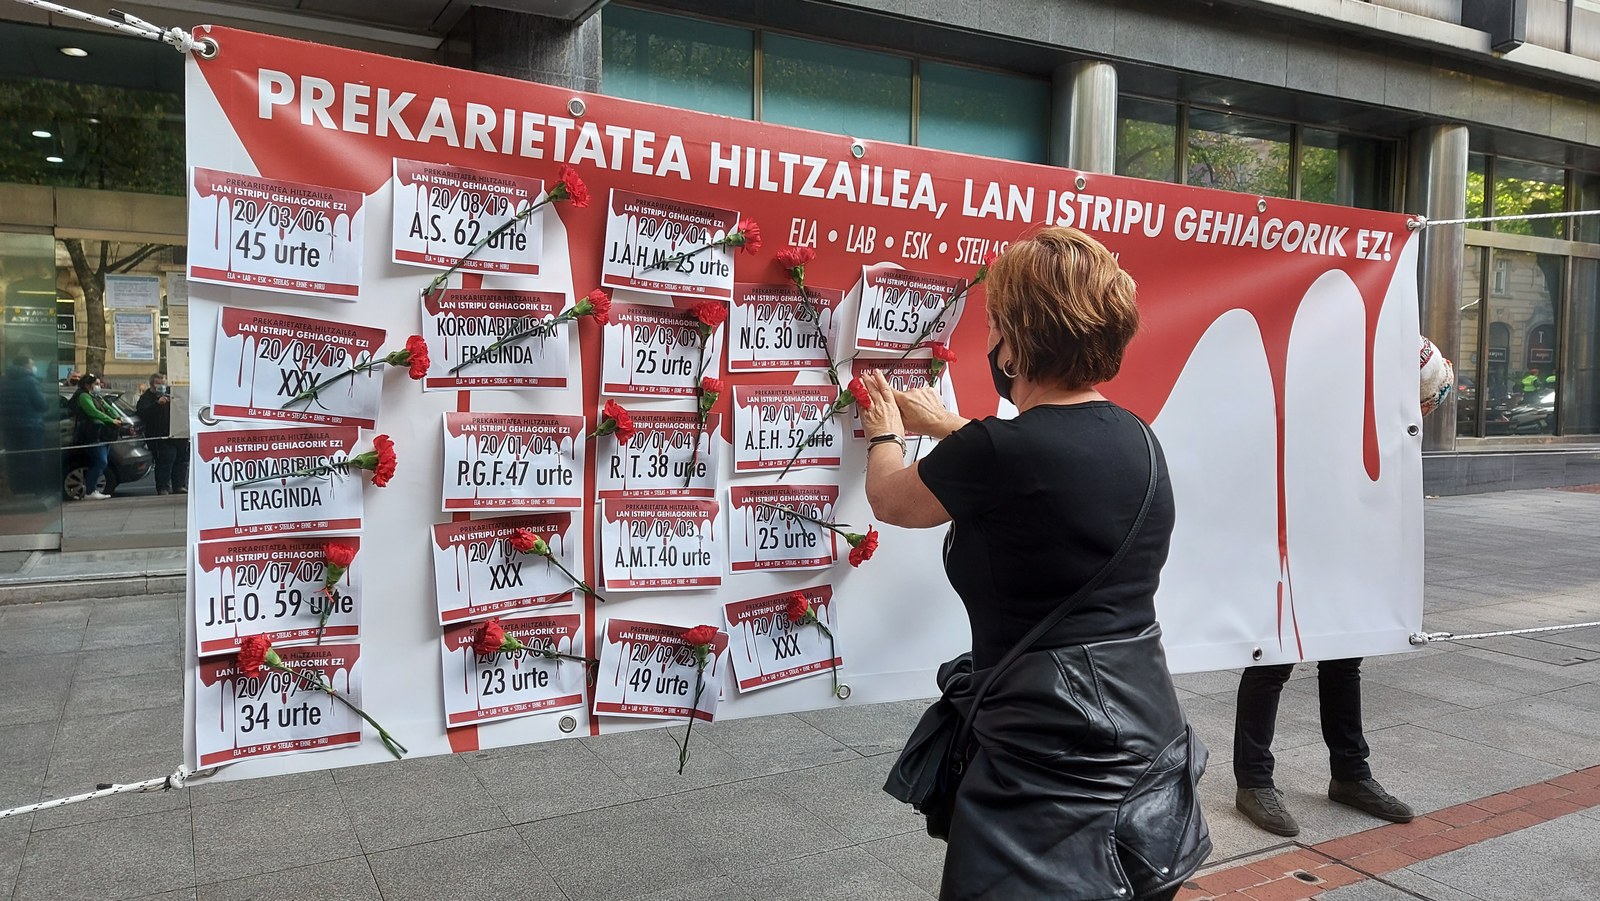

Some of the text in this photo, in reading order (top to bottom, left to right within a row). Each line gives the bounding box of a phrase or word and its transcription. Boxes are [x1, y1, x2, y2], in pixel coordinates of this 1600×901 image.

[258, 68, 1393, 262] PREKARIETATEA HILTZAILEA, LAN ISTRIPU GEHIAGORIK EZ!
[212, 184, 347, 210] LAN ISTRIPU GEHIAGORIK EZ!
[226, 178, 334, 200] PREKARIETATEA HILTZAILEA
[412, 173, 527, 197] LAN ISTRIPU GEHIAGORIK EZ!
[432, 188, 508, 218] 20/08/19
[234, 199, 325, 233] 20/03/06
[641, 207, 667, 217] ISTRIPU
[669, 212, 711, 224] GEHIAGORIK
[714, 219, 724, 228] EZ!
[410, 212, 446, 242] A.S.
[454, 219, 480, 246] 62
[640, 218, 706, 246] 20/09/04
[789, 217, 818, 248] ELA
[846, 224, 877, 254] LAB
[902, 230, 932, 259] ESK
[236, 230, 319, 267] 45 urte
[675, 252, 695, 273] 25
[700, 259, 729, 277] urte
[885, 288, 941, 311] 20/10/07
[239, 323, 369, 348] LAN ISTRIPU GEHIAGORIK EZ!
[635, 326, 696, 350] 20/03/09
[740, 327, 827, 349] N.G. 30 urte
[260, 338, 346, 369] 20/04/19
[636, 350, 692, 376] 25 urte
[763, 404, 818, 425] 20/01/22
[215, 440, 343, 453] LAN ISTRIPU GEHIAGORIK EZ!
[481, 435, 552, 459] 20/01/04
[630, 431, 691, 453] 20/01/04
[745, 429, 833, 450] A.E.H. 52 urte
[537, 465, 572, 486] urte
[648, 455, 668, 478] 38
[241, 487, 322, 511] ERAGINDA
[450, 534, 466, 542] LAN
[468, 529, 495, 540] ISTRIPU
[632, 520, 694, 542] 20/02/03
[759, 527, 816, 549] 25 urte
[236, 553, 268, 562] ISTRIPU
[683, 549, 710, 566] urte
[237, 561, 323, 590] 20/07/02
[490, 562, 523, 591] XXX
[205, 589, 302, 626] J.E.O. 59
[459, 636, 474, 644] LAN
[635, 634, 660, 642] ISTRIPU
[772, 633, 801, 660] XXX
[216, 658, 344, 677] LAN EZ!
[482, 668, 548, 696] 23 urte
[630, 668, 688, 696] 49 urte
[241, 702, 321, 732] 34 urte
